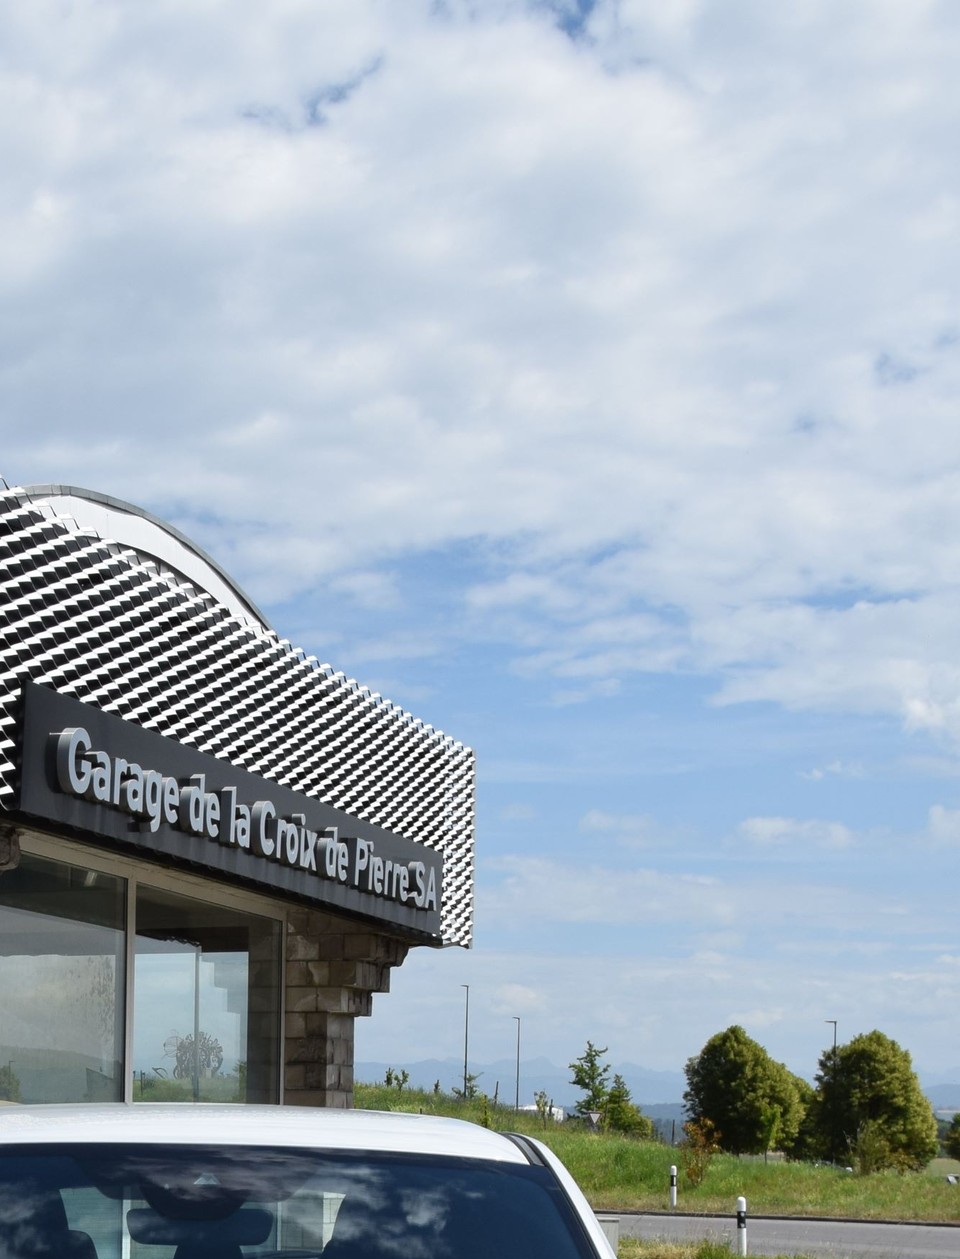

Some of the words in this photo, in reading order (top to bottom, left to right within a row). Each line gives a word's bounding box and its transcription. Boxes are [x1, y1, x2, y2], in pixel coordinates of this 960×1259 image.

[58, 727, 180, 832] Garage
[184, 774, 221, 837] de
[225, 786, 251, 848] la
[254, 800, 318, 871] Croix
[321, 827, 349, 881] de
[352, 837, 410, 901] Pierre
[412, 861, 438, 911] SA
